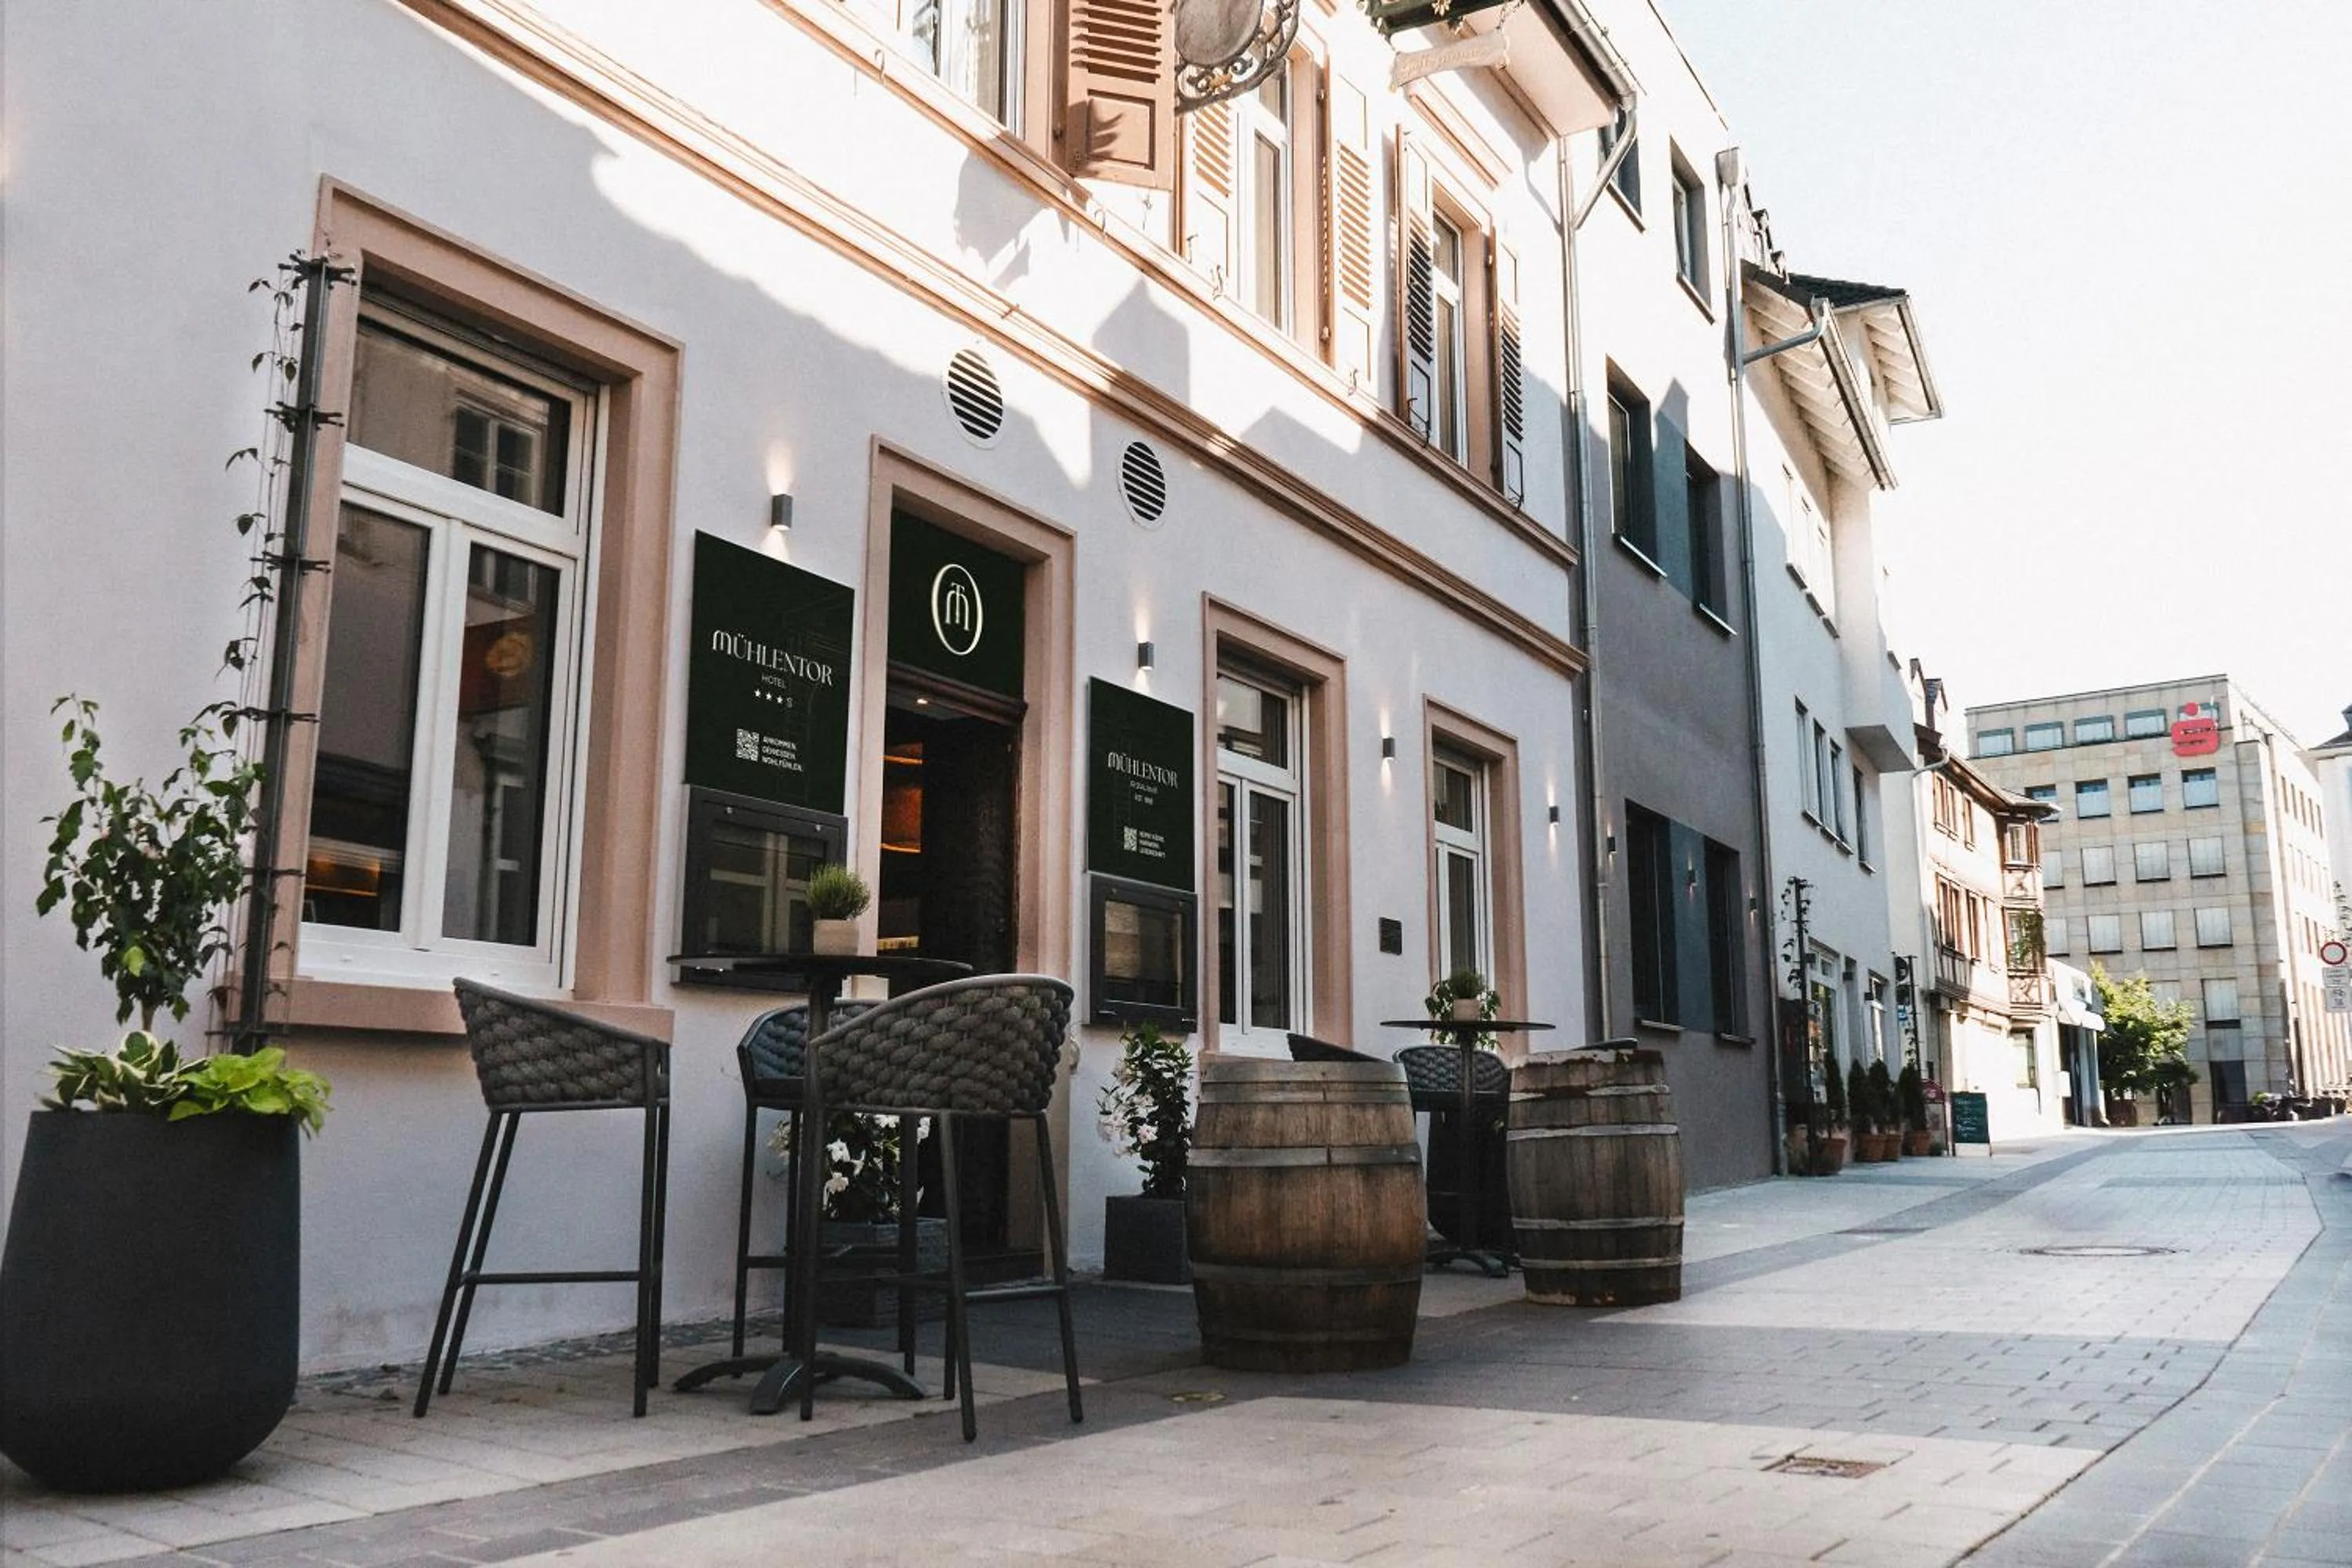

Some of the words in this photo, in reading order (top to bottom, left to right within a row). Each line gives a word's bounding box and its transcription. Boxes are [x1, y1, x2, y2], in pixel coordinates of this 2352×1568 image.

[712, 630, 833, 687] MÜHLENTOR
[761, 674, 787, 689] HOTEL
[1108, 752, 1178, 789] MÜHLENTOR
